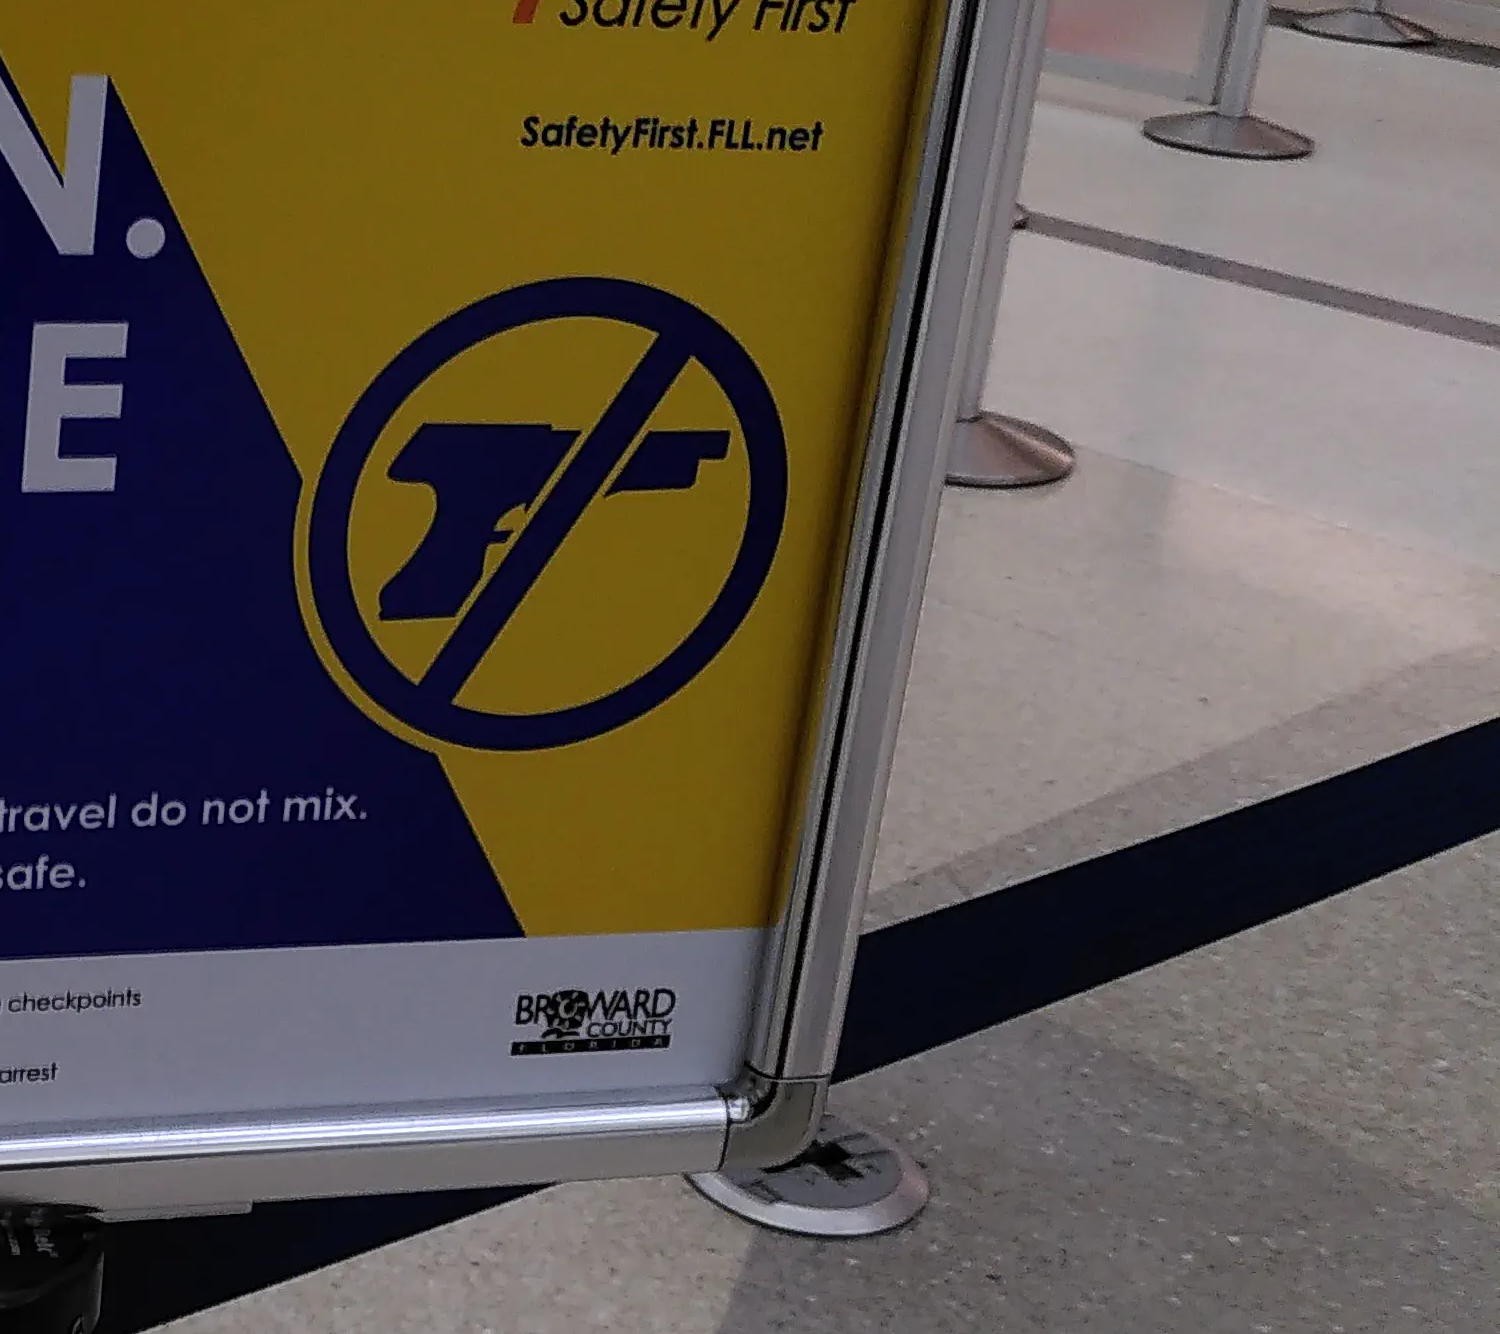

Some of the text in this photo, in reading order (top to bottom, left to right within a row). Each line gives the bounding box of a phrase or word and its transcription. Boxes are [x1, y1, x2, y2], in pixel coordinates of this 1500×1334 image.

[520, 115, 823, 155] SafetyFirst.FLL.net
[131, 791, 187, 828] do
[202, 787, 270, 825] not
[283, 786, 368, 822] mix.
[7, 987, 143, 1013] checkpoints
[586, 1019, 673, 1038] COUNTY
